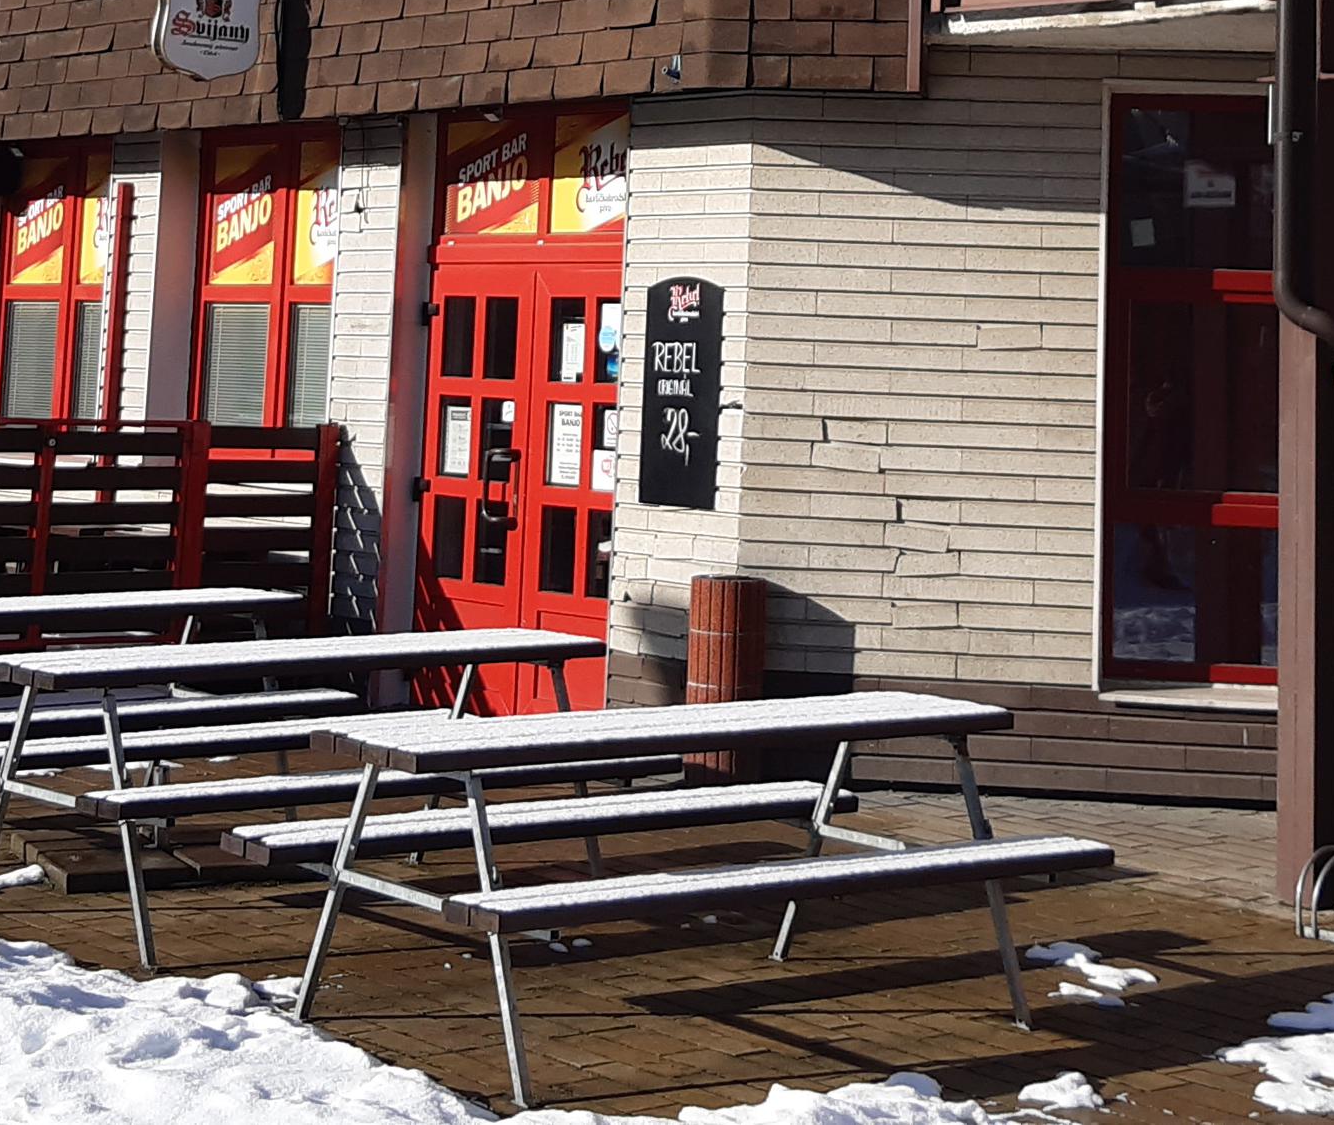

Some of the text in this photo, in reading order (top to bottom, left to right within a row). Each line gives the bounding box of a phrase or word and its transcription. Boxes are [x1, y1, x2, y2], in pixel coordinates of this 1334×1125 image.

[170, 9, 250, 44] Svijany
[458, 132, 528, 187] SPORT BAR
[217, 174, 272, 222] SPORT BAR
[457, 155, 528, 223] BANJO
[17, 202, 64, 255] BANJO
[216, 193, 273, 254] BANJO
[652, 341, 701, 373] REBEL
